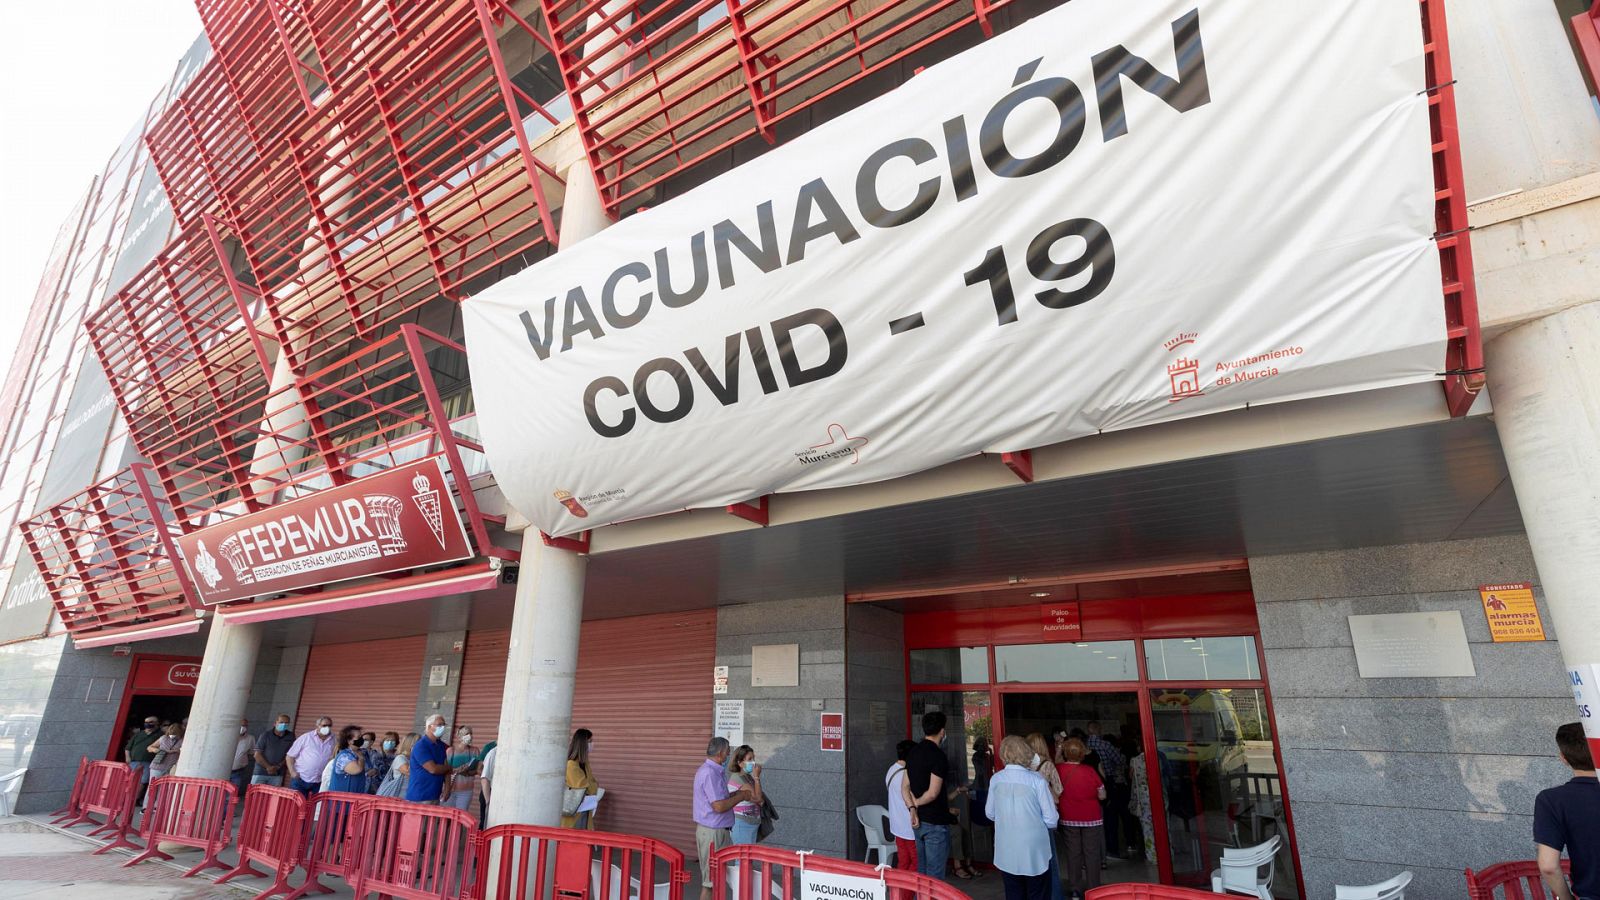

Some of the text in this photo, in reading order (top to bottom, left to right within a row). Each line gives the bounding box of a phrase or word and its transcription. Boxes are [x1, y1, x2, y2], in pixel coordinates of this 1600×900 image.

[519, 8, 1211, 361] VACUNACIÓN
[583, 217, 1116, 438] COVID - 19
[1215, 345, 1304, 372] Ayuntamiento
[1216, 366, 1279, 386] de Murcia
[795, 447, 817, 457] Servicio
[799, 447, 852, 465] Murciano
[236, 497, 374, 566] FEPEMUR
[292, 561, 303, 572] DE
[302, 555, 326, 570] PEÑAS
[325, 544, 379, 565] MURCIANISTAS
[1489, 612, 1537, 620] alarmas
[1494, 618, 1535, 627] murcia
[1043, 623, 1080, 631] Autoridades
[809, 882, 874, 900] VACUNACIÓN
